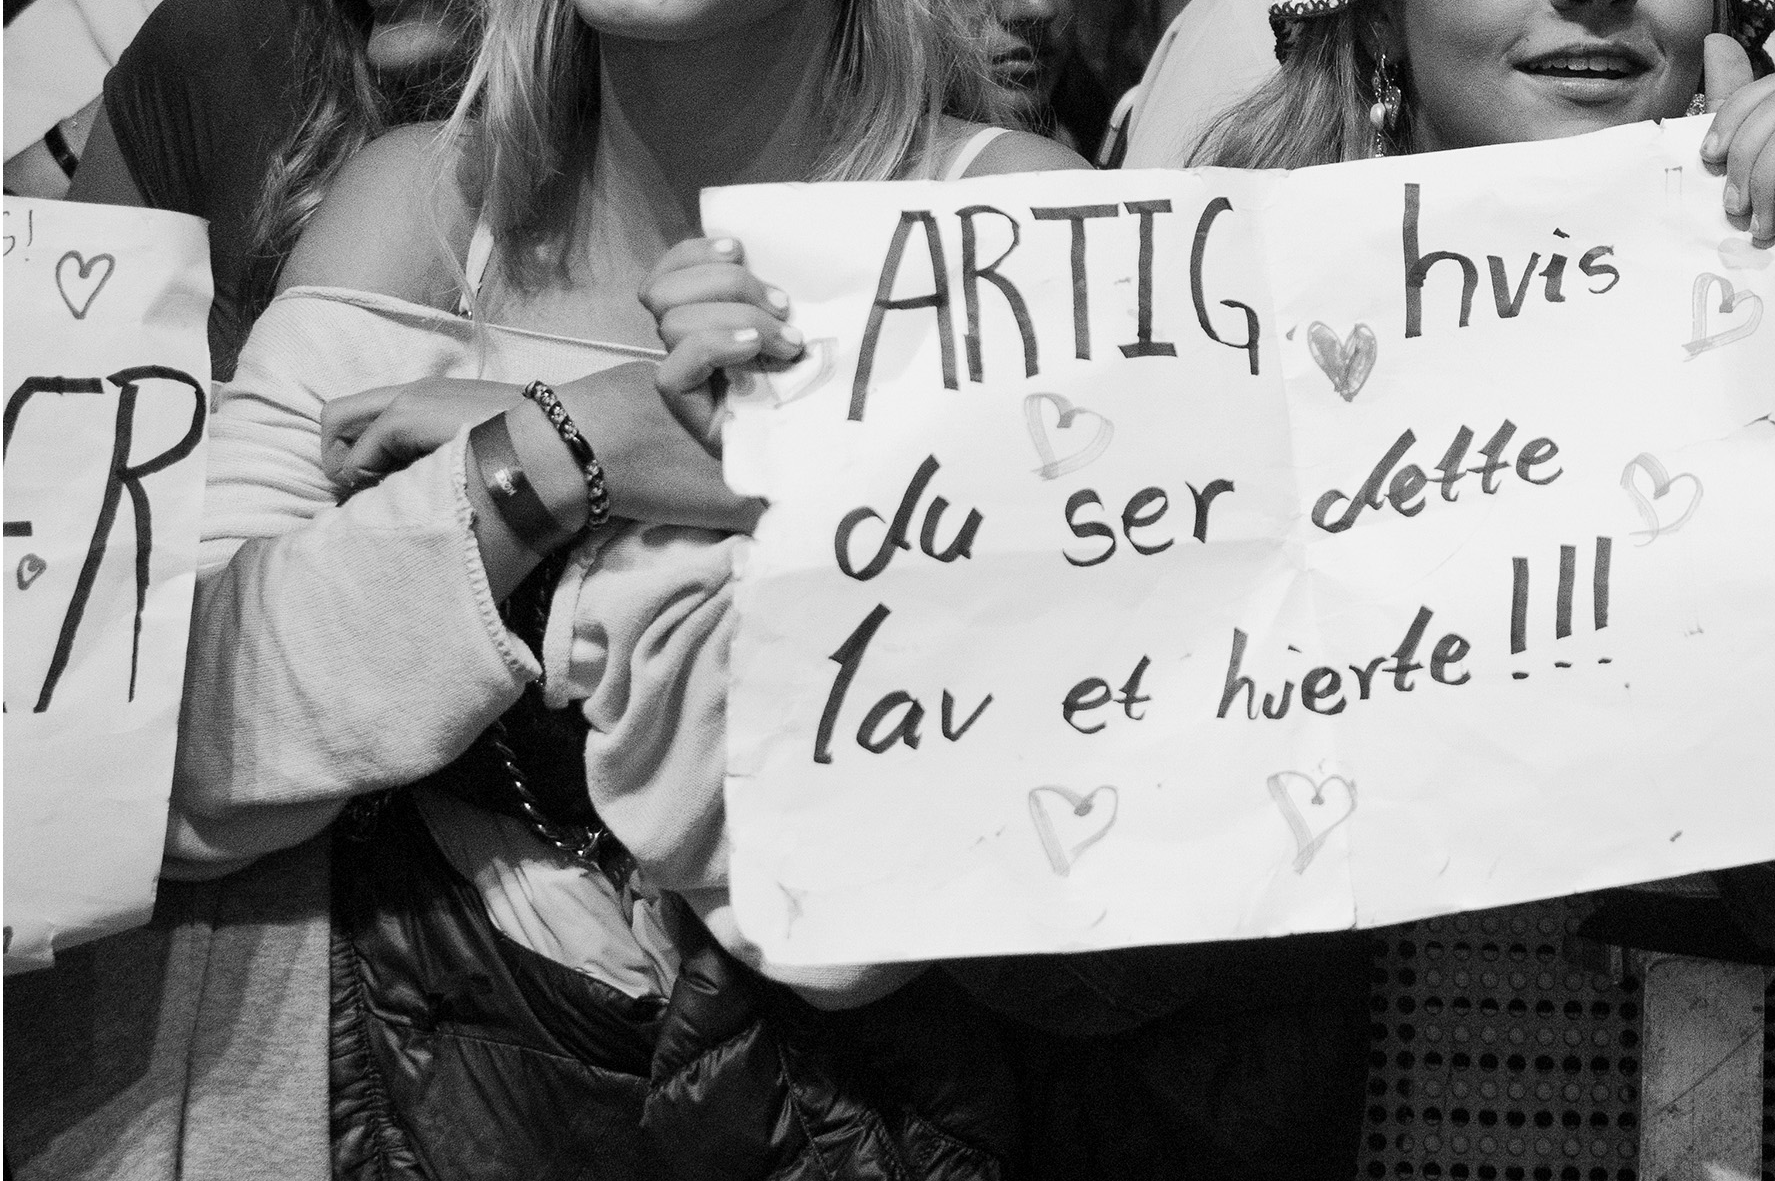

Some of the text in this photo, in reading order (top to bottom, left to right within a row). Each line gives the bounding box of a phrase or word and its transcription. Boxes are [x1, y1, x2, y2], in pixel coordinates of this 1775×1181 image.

[848, 183, 1622, 421] ARTIG hvis
[834, 419, 1565, 582] du ser dette
[812, 603, 993, 765] lav
[1061, 654, 1152, 734] et
